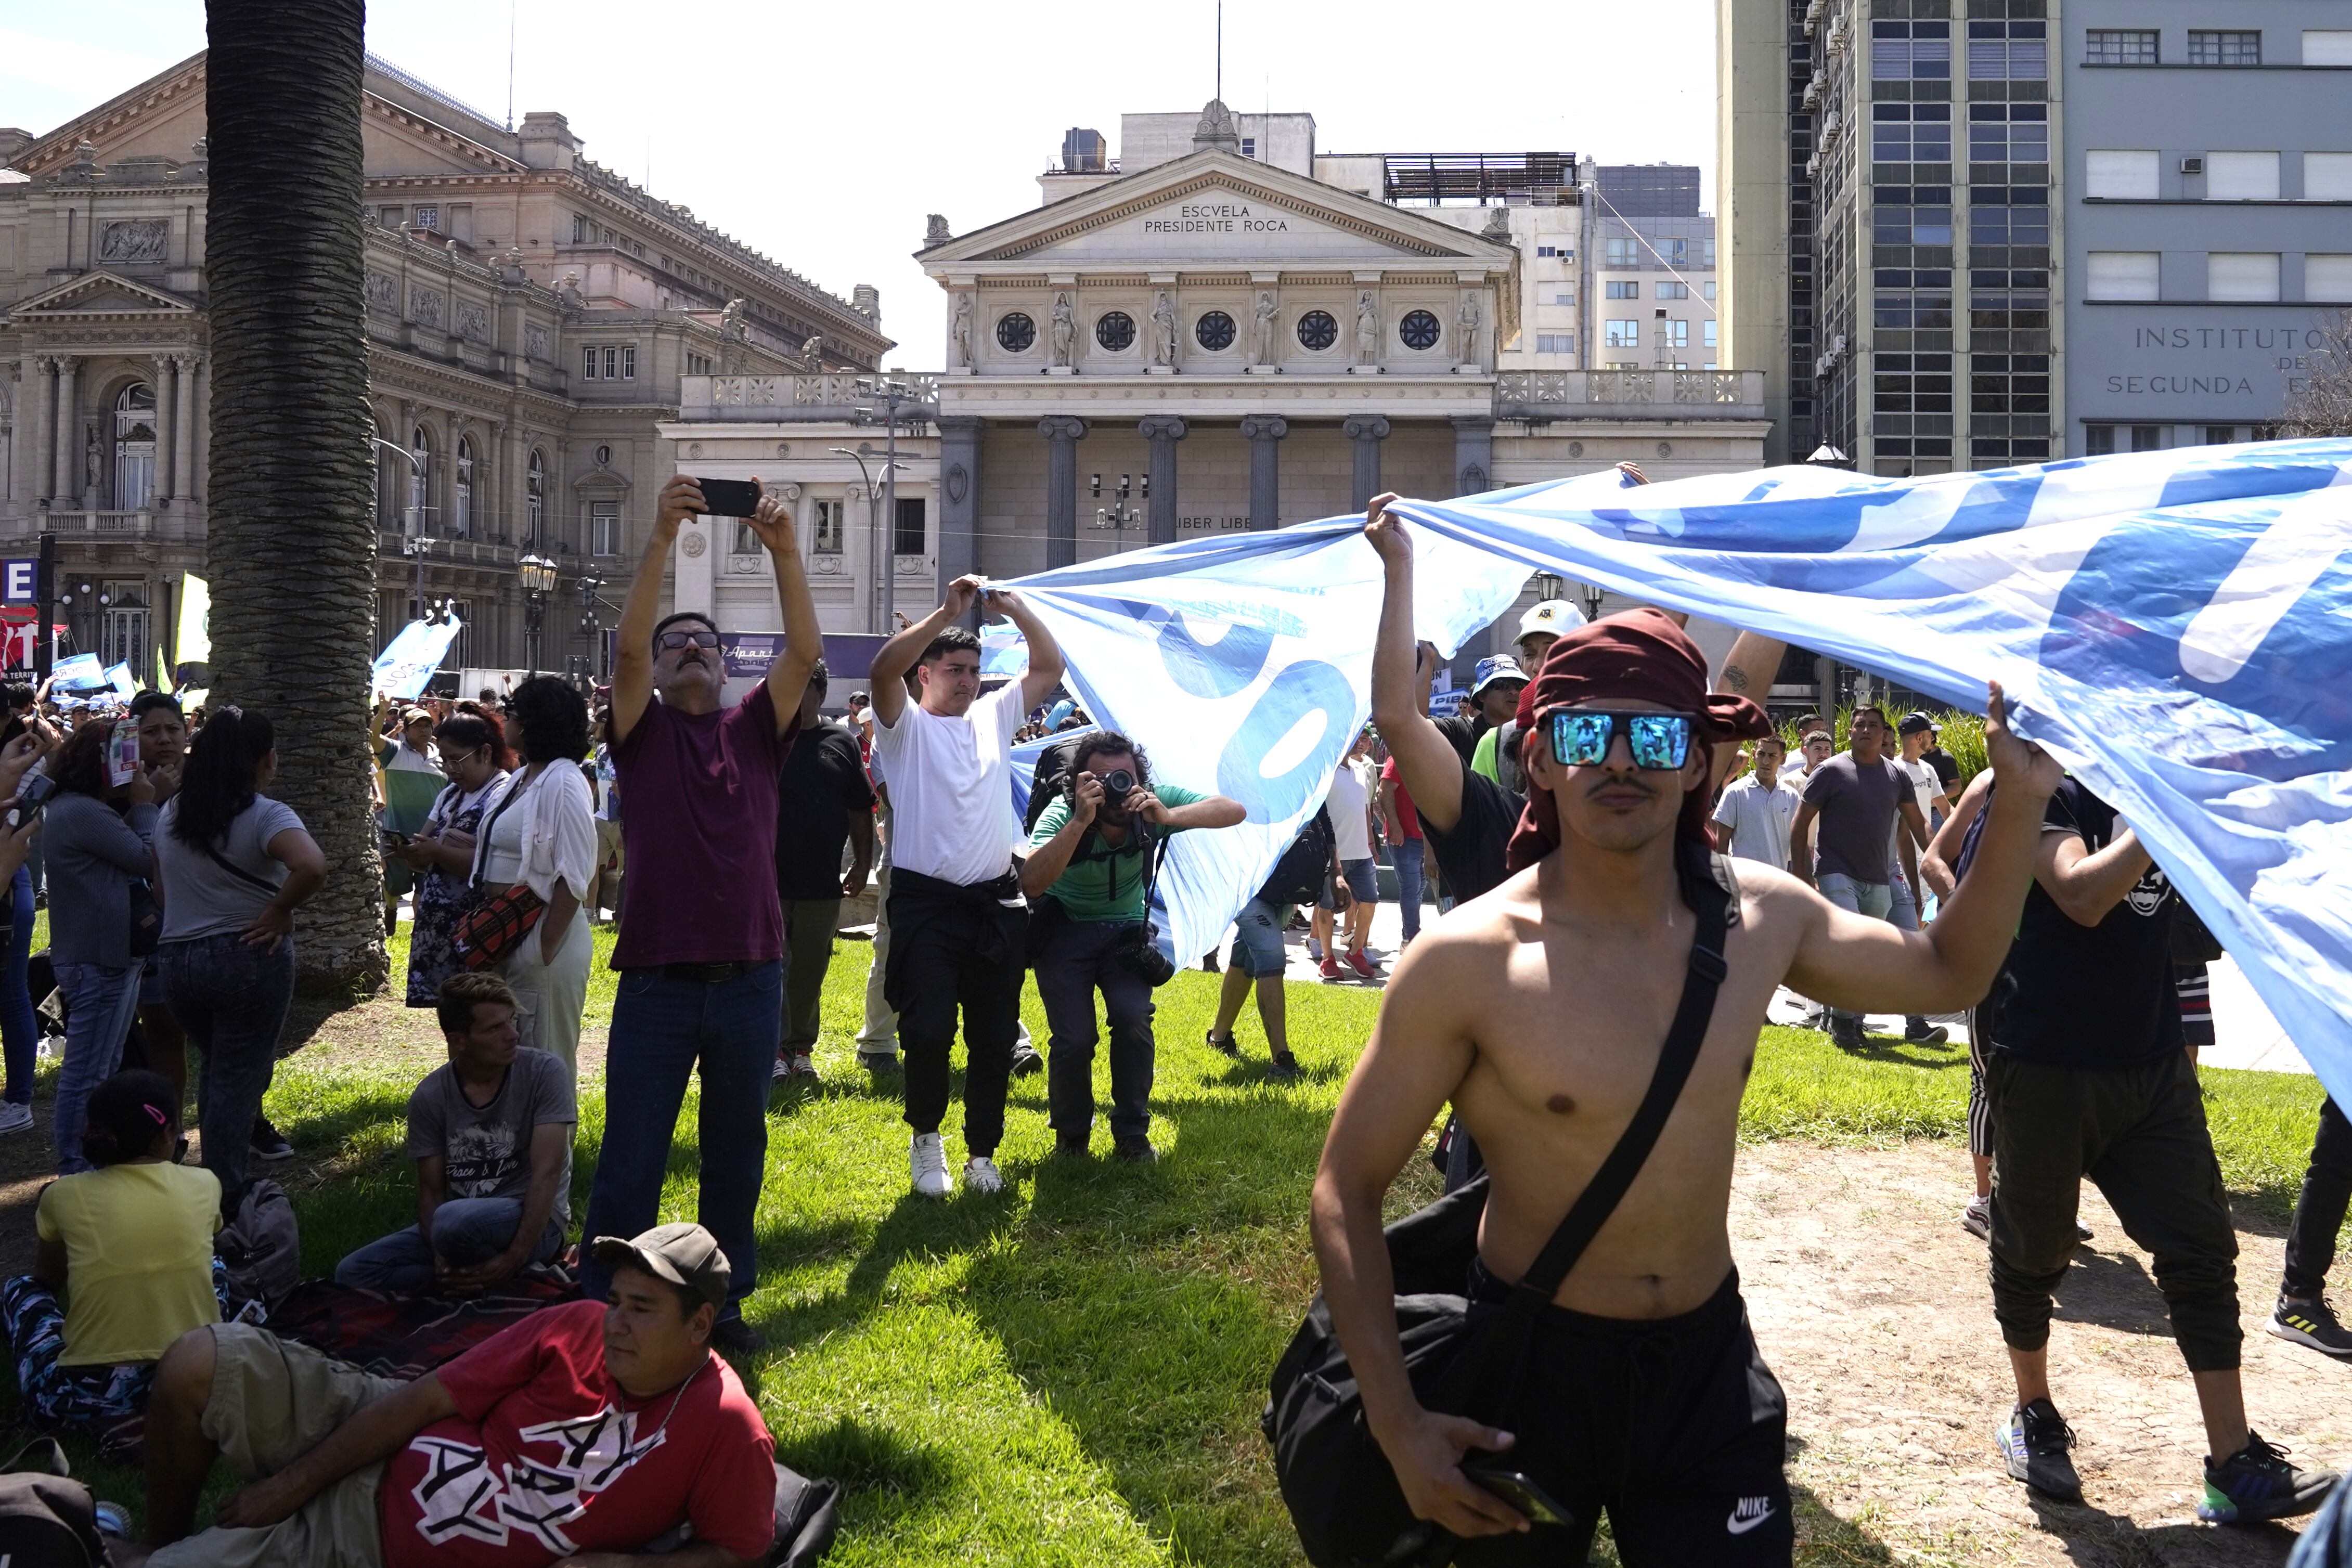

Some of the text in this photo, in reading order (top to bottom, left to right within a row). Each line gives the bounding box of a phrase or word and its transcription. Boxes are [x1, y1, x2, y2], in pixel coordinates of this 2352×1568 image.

[1182, 206, 1250, 217] ESCVELA
[1145, 221, 1288, 232] PRESIDENTE ROCA
[2136, 328, 2322, 349] INSTITUTO
[2279, 357, 2308, 370] DE
[2107, 376, 2253, 395] SEGUNDA
[1177, 517, 1212, 528] IBER
[8, 563, 32, 599] E
[726, 645, 776, 660] Apart
[1435, 695, 1463, 705] PIB
[445, 1158, 519, 1177] Peace & Love
[1736, 1496, 1769, 1517] NIKE
